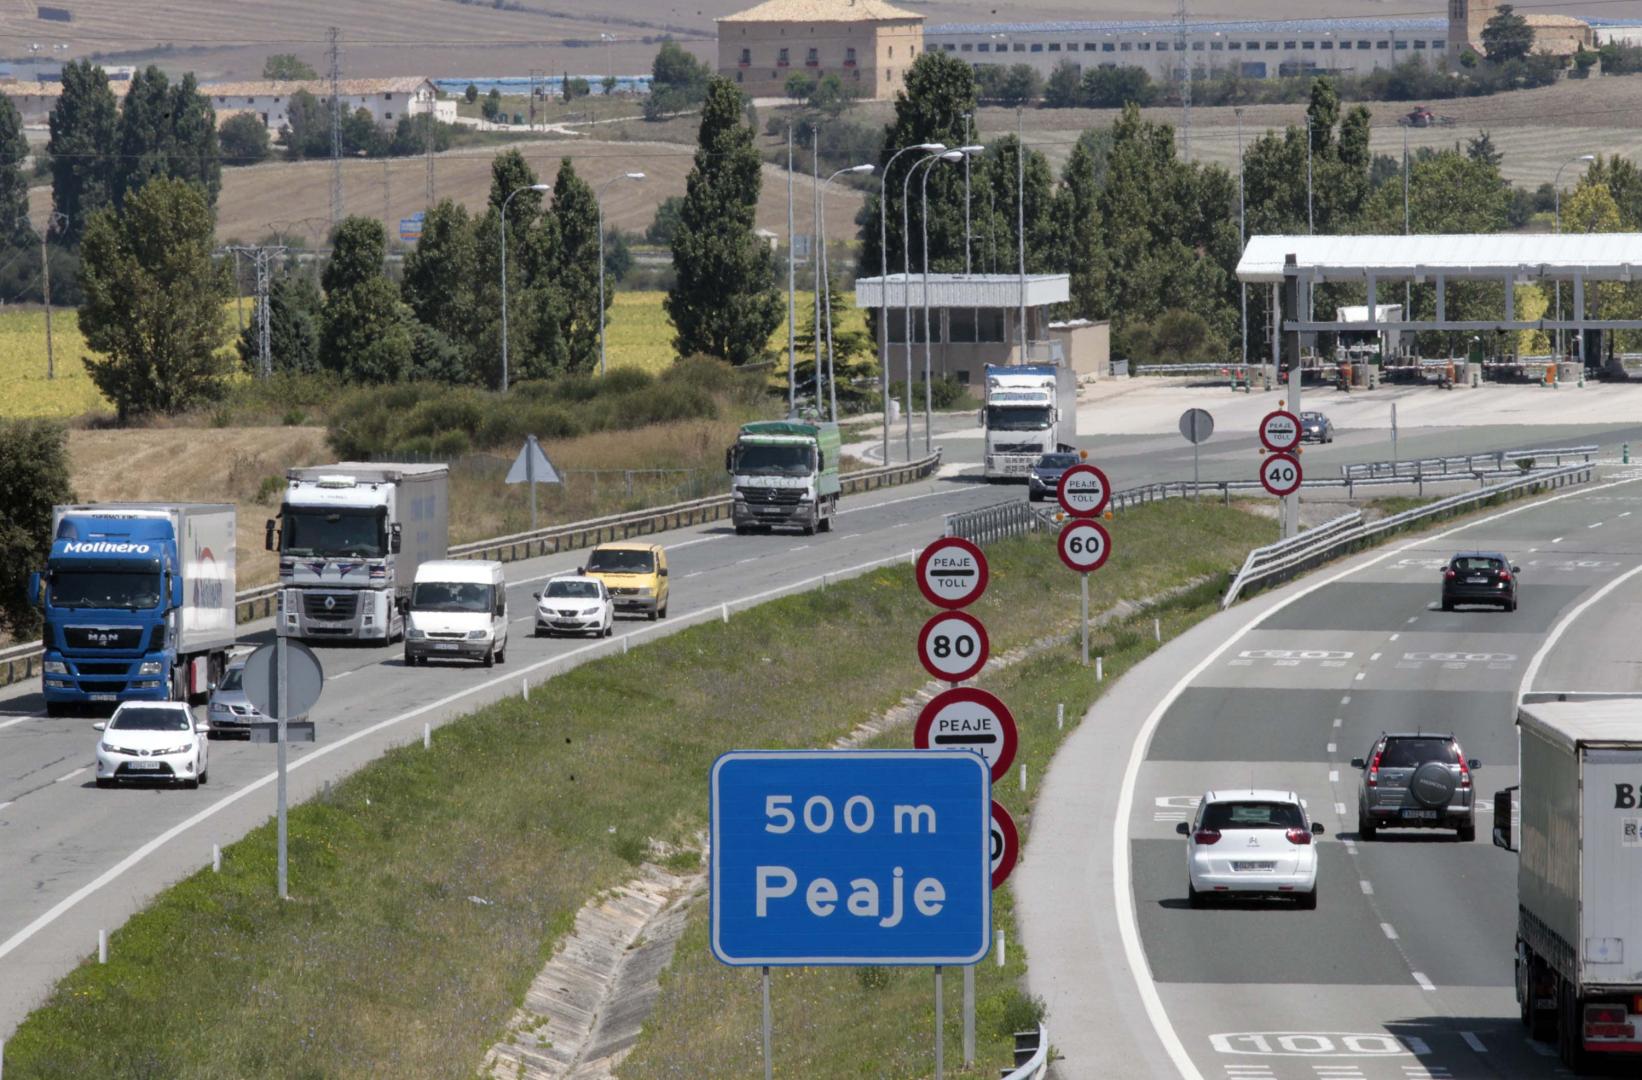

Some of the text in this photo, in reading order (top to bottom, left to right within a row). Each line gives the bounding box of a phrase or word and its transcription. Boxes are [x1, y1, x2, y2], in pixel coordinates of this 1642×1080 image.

[1269, 468, 1294, 482] 40
[1069, 480, 1098, 488] PEAJE
[1073, 494, 1094, 502] TOLL
[63, 541, 150, 554] Molinero
[1069, 536, 1100, 554] 60
[934, 557, 971, 567] PEAJE
[938, 578, 967, 587] TOLL
[87, 633, 119, 642] MAN
[933, 634, 976, 659] 80
[939, 718, 992, 732] PEAJE
[1614, 783, 1642, 809] B
[765, 794, 937, 834] 500 m
[755, 865, 946, 928] Peaje
[1238, 1034, 1402, 1053] 100
